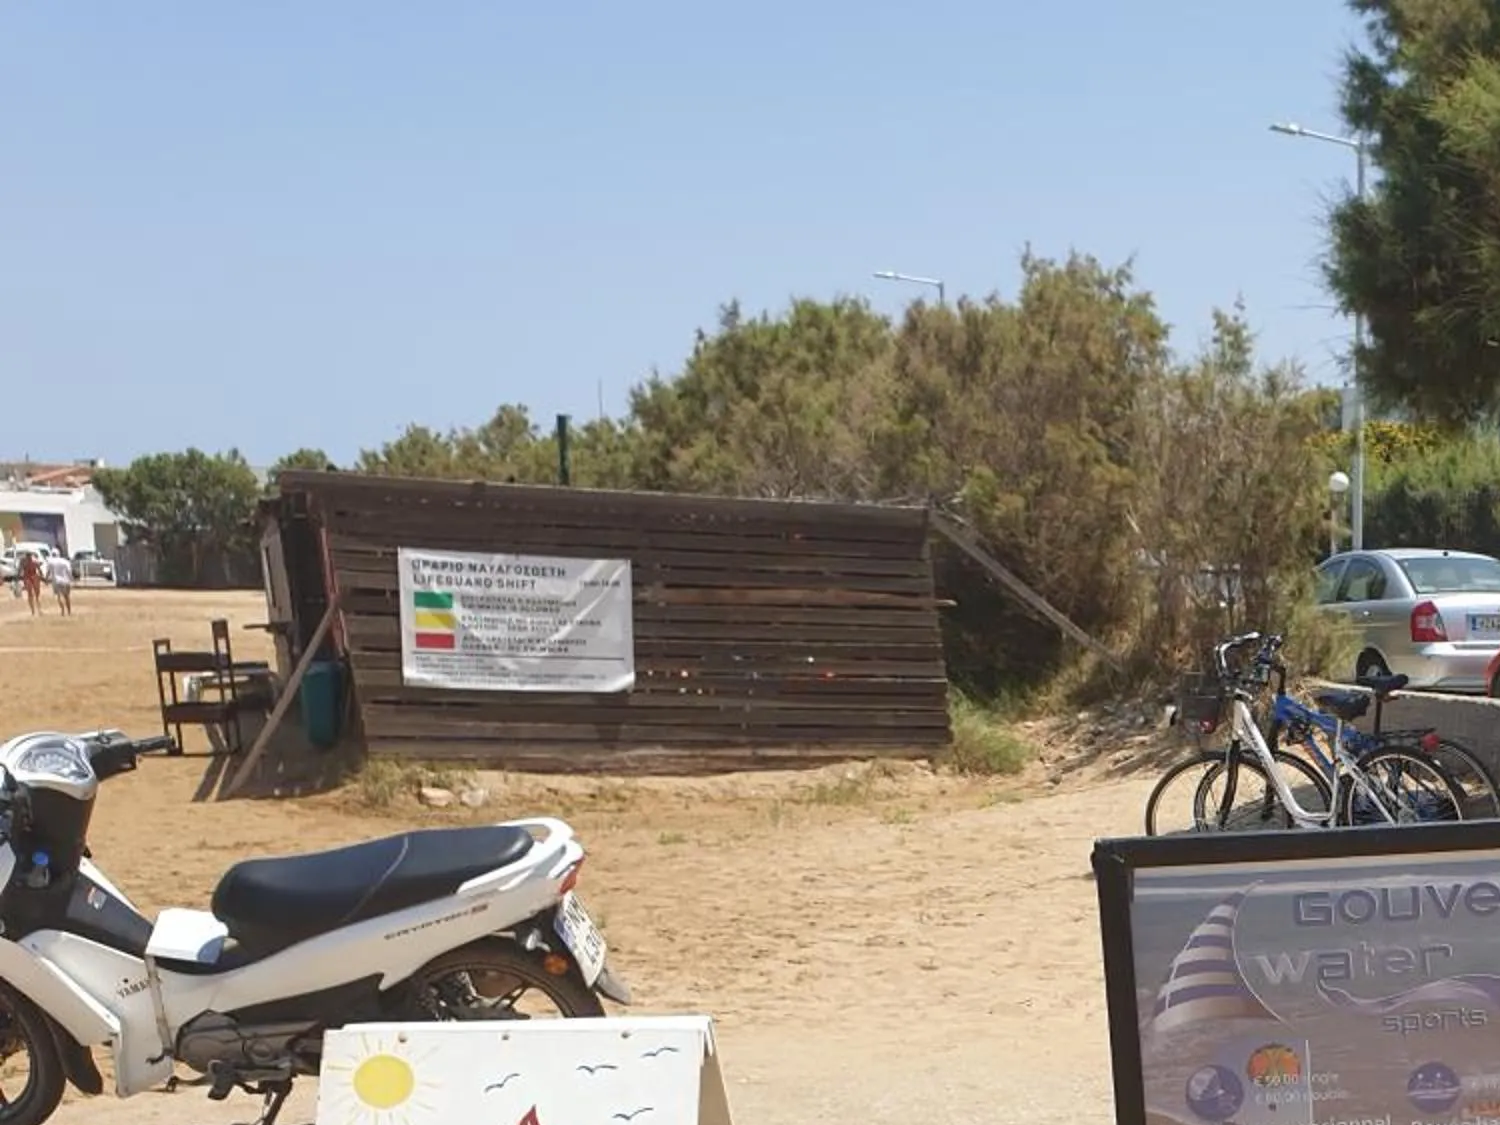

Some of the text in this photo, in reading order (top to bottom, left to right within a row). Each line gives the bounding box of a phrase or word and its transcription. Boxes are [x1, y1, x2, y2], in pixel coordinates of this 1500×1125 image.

[497, 577, 536, 590] SHIFT
[1251, 941, 1453, 986] water
[1383, 1007, 1488, 1034] sports
